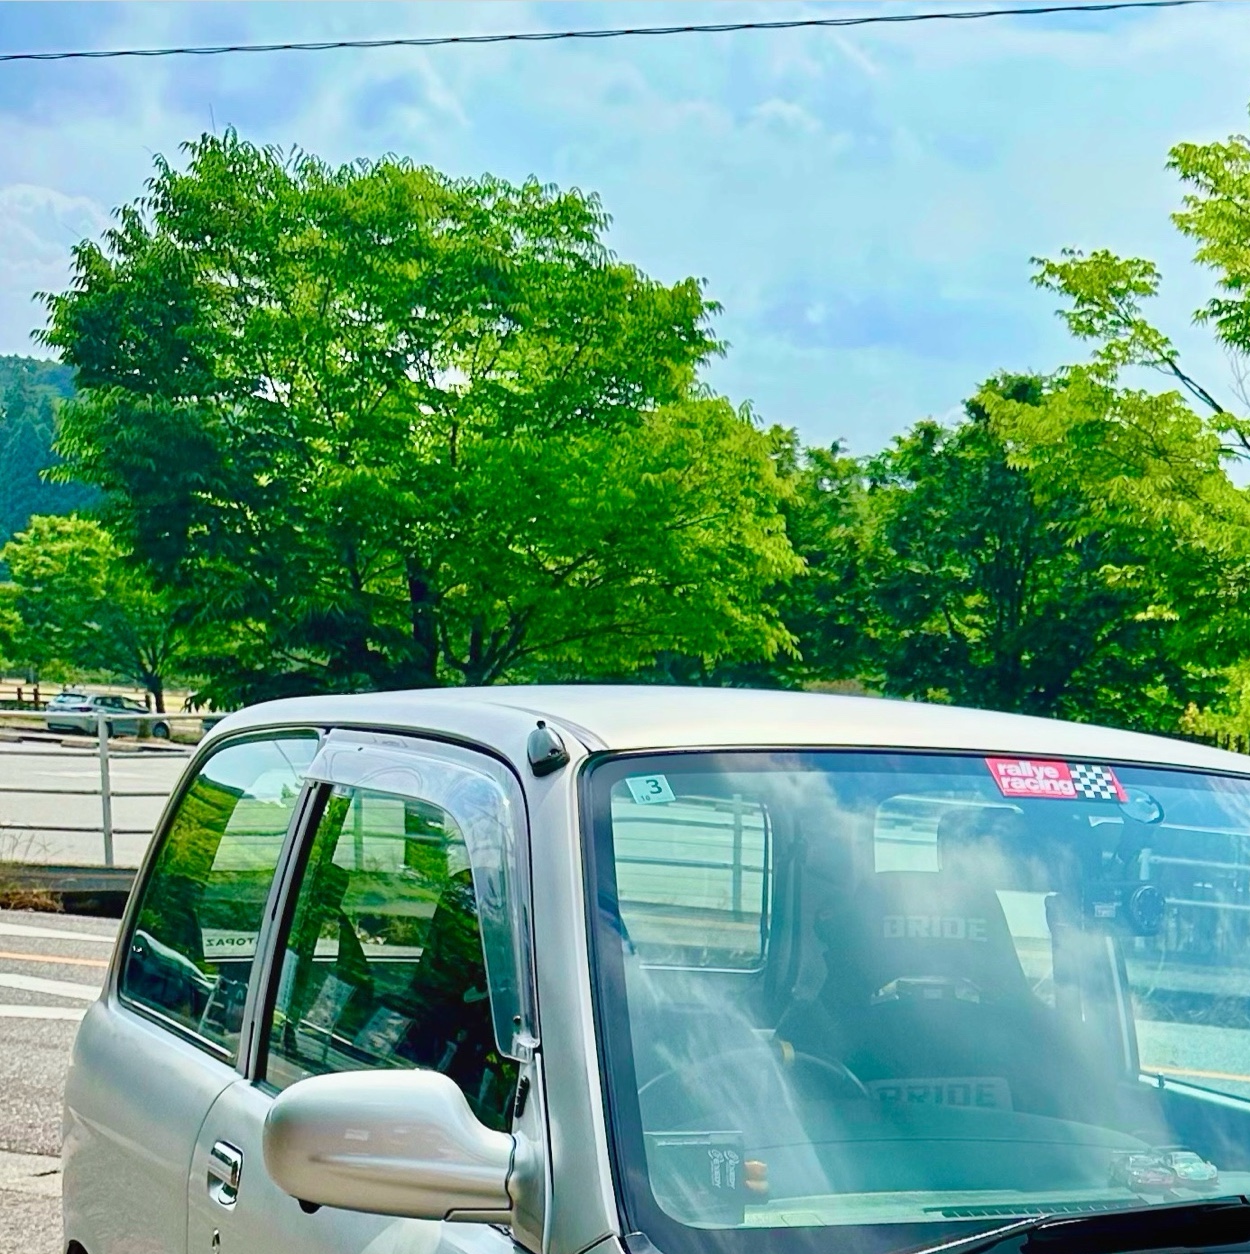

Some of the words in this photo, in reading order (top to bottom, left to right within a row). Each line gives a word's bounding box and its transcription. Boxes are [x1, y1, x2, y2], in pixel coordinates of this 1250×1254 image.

[996, 761, 1060, 779] rallye
[645, 779, 663, 794] 3
[1000, 775, 1076, 796] racing
[883, 914, 988, 942] BRIDE
